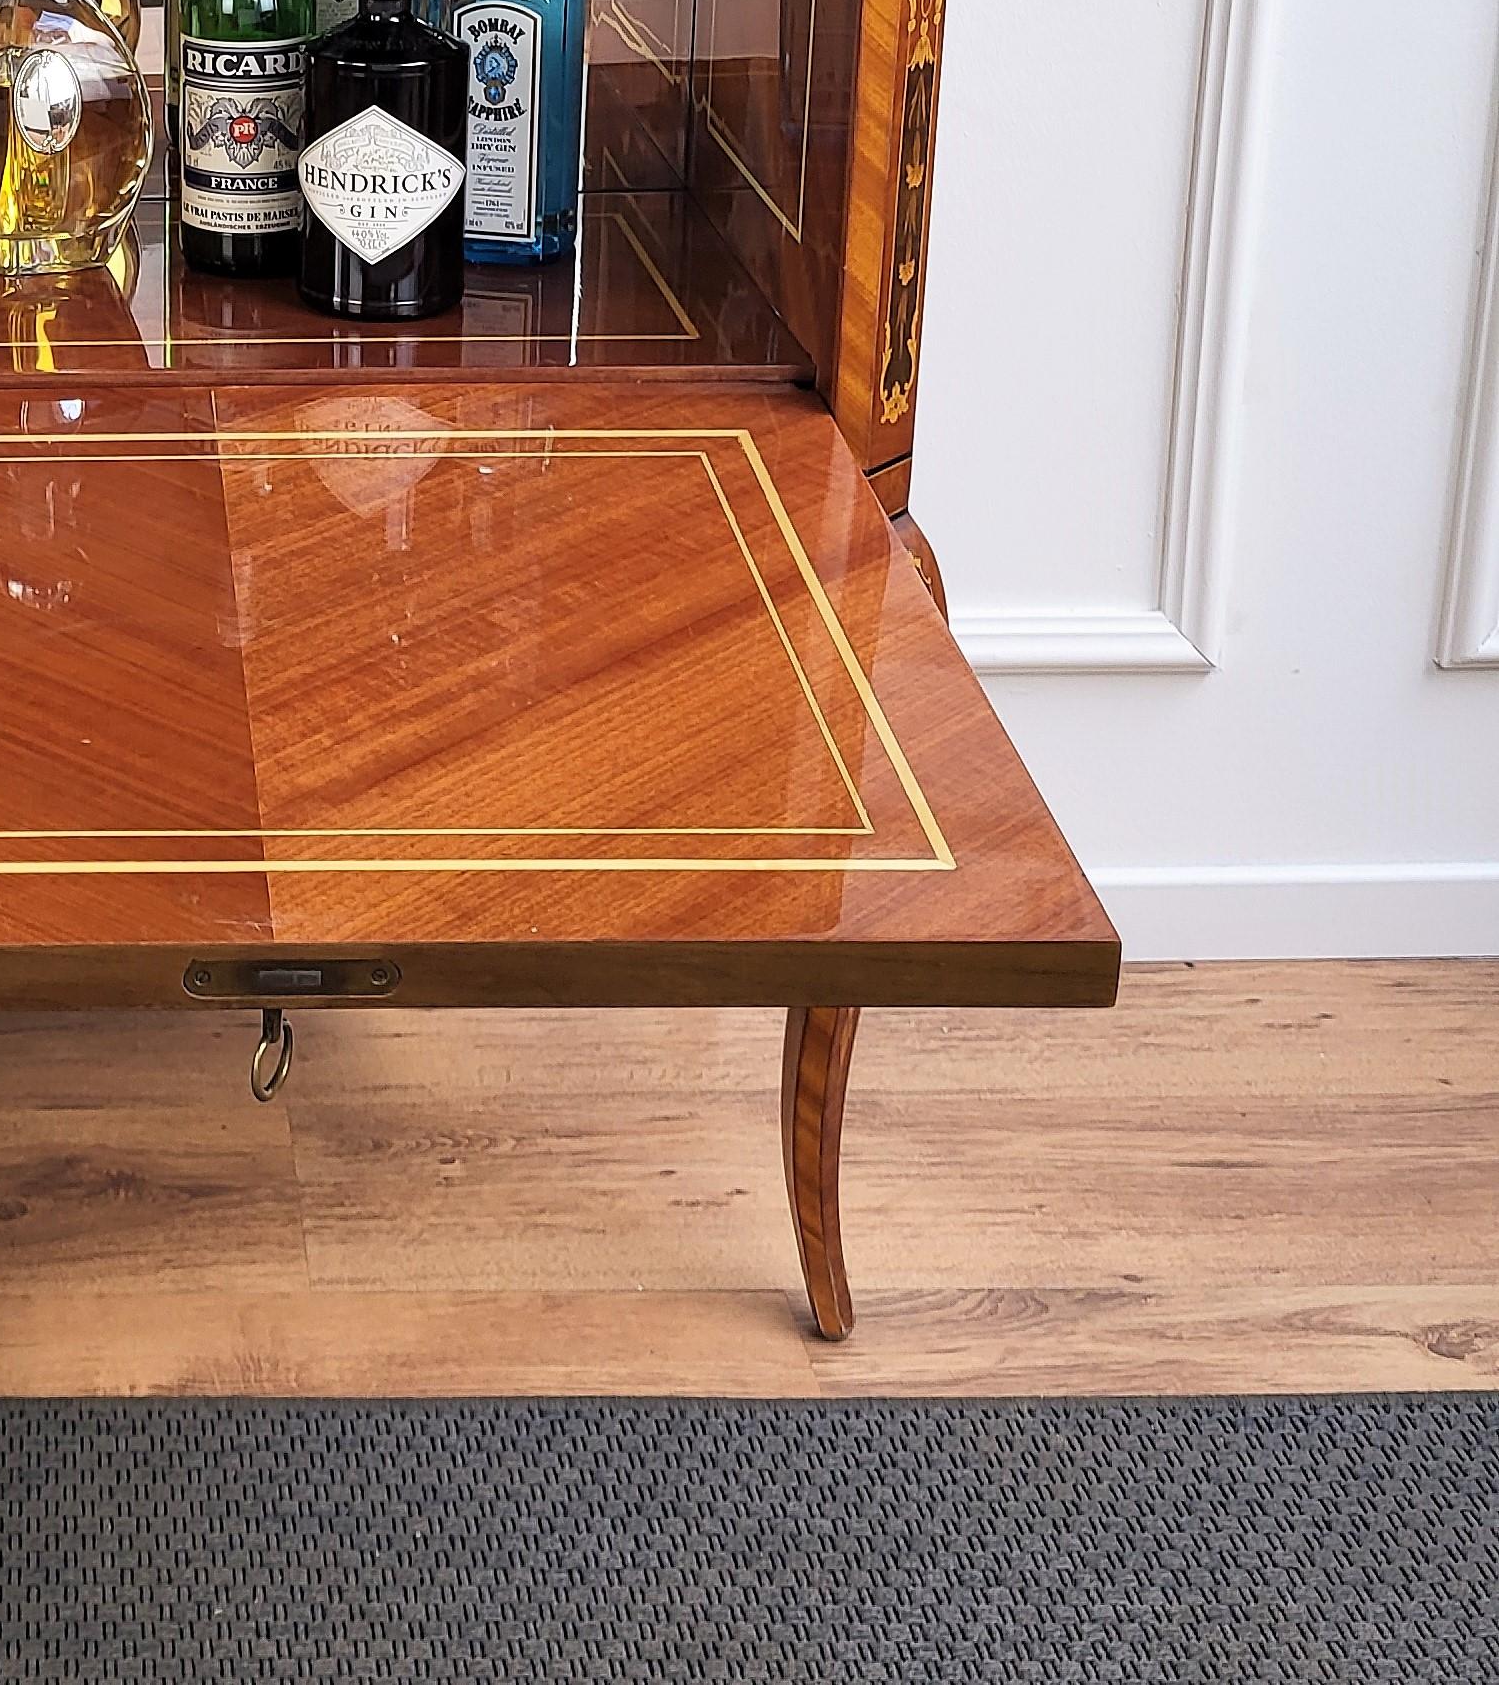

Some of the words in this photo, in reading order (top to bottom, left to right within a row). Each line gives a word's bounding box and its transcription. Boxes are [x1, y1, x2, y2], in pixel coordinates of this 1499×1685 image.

[467, 17, 526, 45] BOMBAY
[186, 48, 304, 76] RICARD
[468, 95, 527, 122] SAPPHIRE
[232, 123, 256, 138] PR
[471, 143, 493, 151] DRY
[495, 144, 516, 153] GIN
[210, 177, 278, 191] FRANCE
[304, 163, 452, 195] HENDRICK'S
[190, 204, 208, 220] VRAI
[210, 210, 244, 223] PASTIS
[246, 212, 261, 222] DE
[350, 203, 397, 219] GIN
